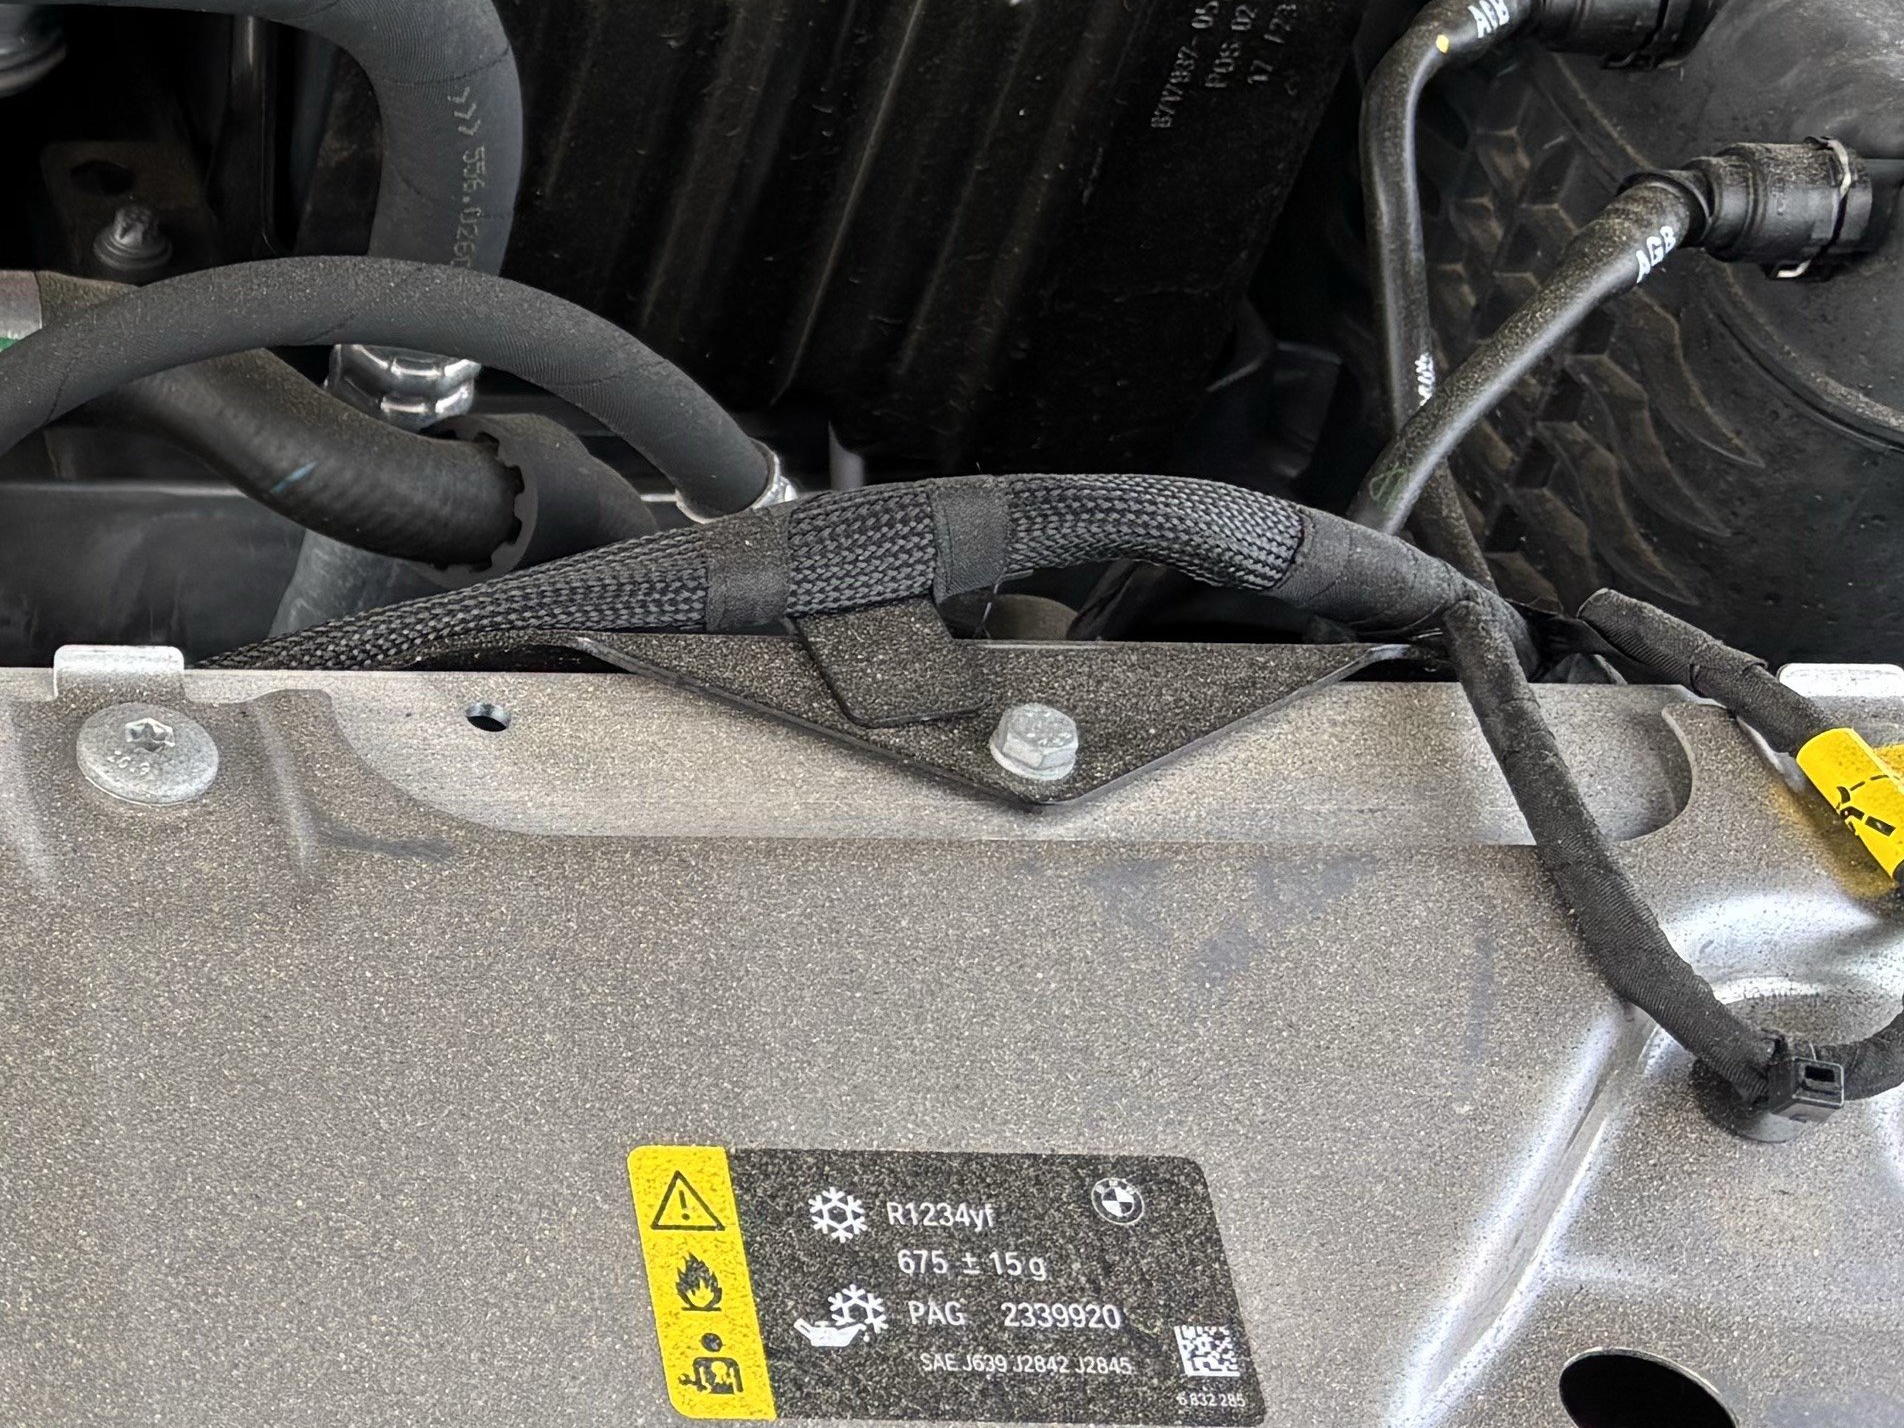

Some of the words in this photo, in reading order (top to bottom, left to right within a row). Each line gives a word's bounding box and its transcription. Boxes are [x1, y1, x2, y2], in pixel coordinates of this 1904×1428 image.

[1635, 224, 1677, 284] AGB
[886, 1201, 993, 1232] R1234yf
[897, 1249, 948, 1274] 675
[961, 1251, 981, 1275] ±
[991, 1251, 1023, 1276] 15
[1028, 1256, 1047, 1281] g
[908, 1299, 966, 1326] PAG
[1000, 1301, 1122, 1330] 2339920
[920, 1353, 962, 1372] SAE
[965, 1353, 1008, 1373] J639
[1012, 1354, 1069, 1374] J2842
[1075, 1355, 1134, 1375] J2845
[1176, 1392, 1187, 1407] 6
[1189, 1392, 1218, 1408] 832
[1219, 1393, 1246, 1408] 285
